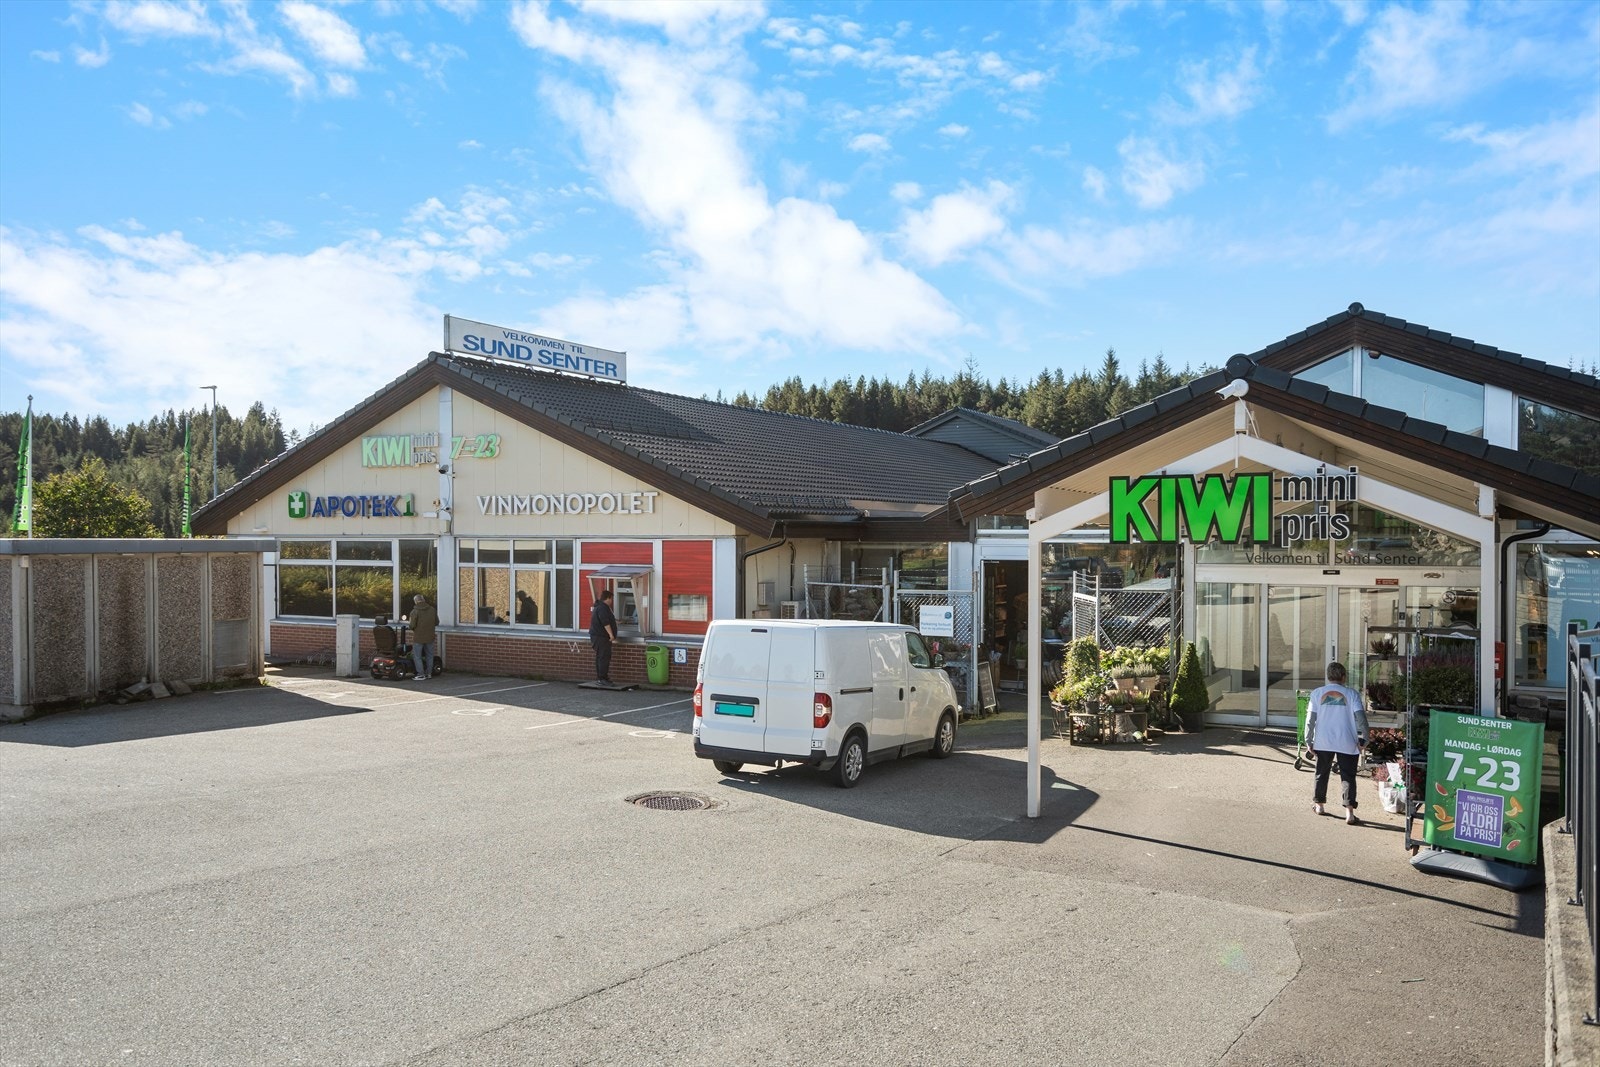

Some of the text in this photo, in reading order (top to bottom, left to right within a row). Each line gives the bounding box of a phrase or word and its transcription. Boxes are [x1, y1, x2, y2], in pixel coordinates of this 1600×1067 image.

[502, 330, 586, 354] VELKOMMEN TIL
[463, 334, 618, 377] SUND SENTER
[362, 432, 436, 467] KIWI mini
[413, 451, 435, 465] pris
[449, 434, 498, 460] 7-23
[312, 495, 400, 517] APOTEK
[476, 492, 659, 516] VINMONOPOLET
[1109, 466, 1359, 544] KIWI mini
[1281, 506, 1351, 548] pris
[1245, 552, 1423, 565] Velkomen til Sund Senter
[1457, 716, 1512, 729] SUND SENTER
[1444, 739, 1481, 751] MANDAG
[1486, 745, 1522, 757] LØRDAG
[1443, 751, 1521, 792] 7-23
[1461, 811, 1498, 830] ALDRI
[1470, 803, 1483, 814] GIR
[1484, 805, 1499, 816] OSS
